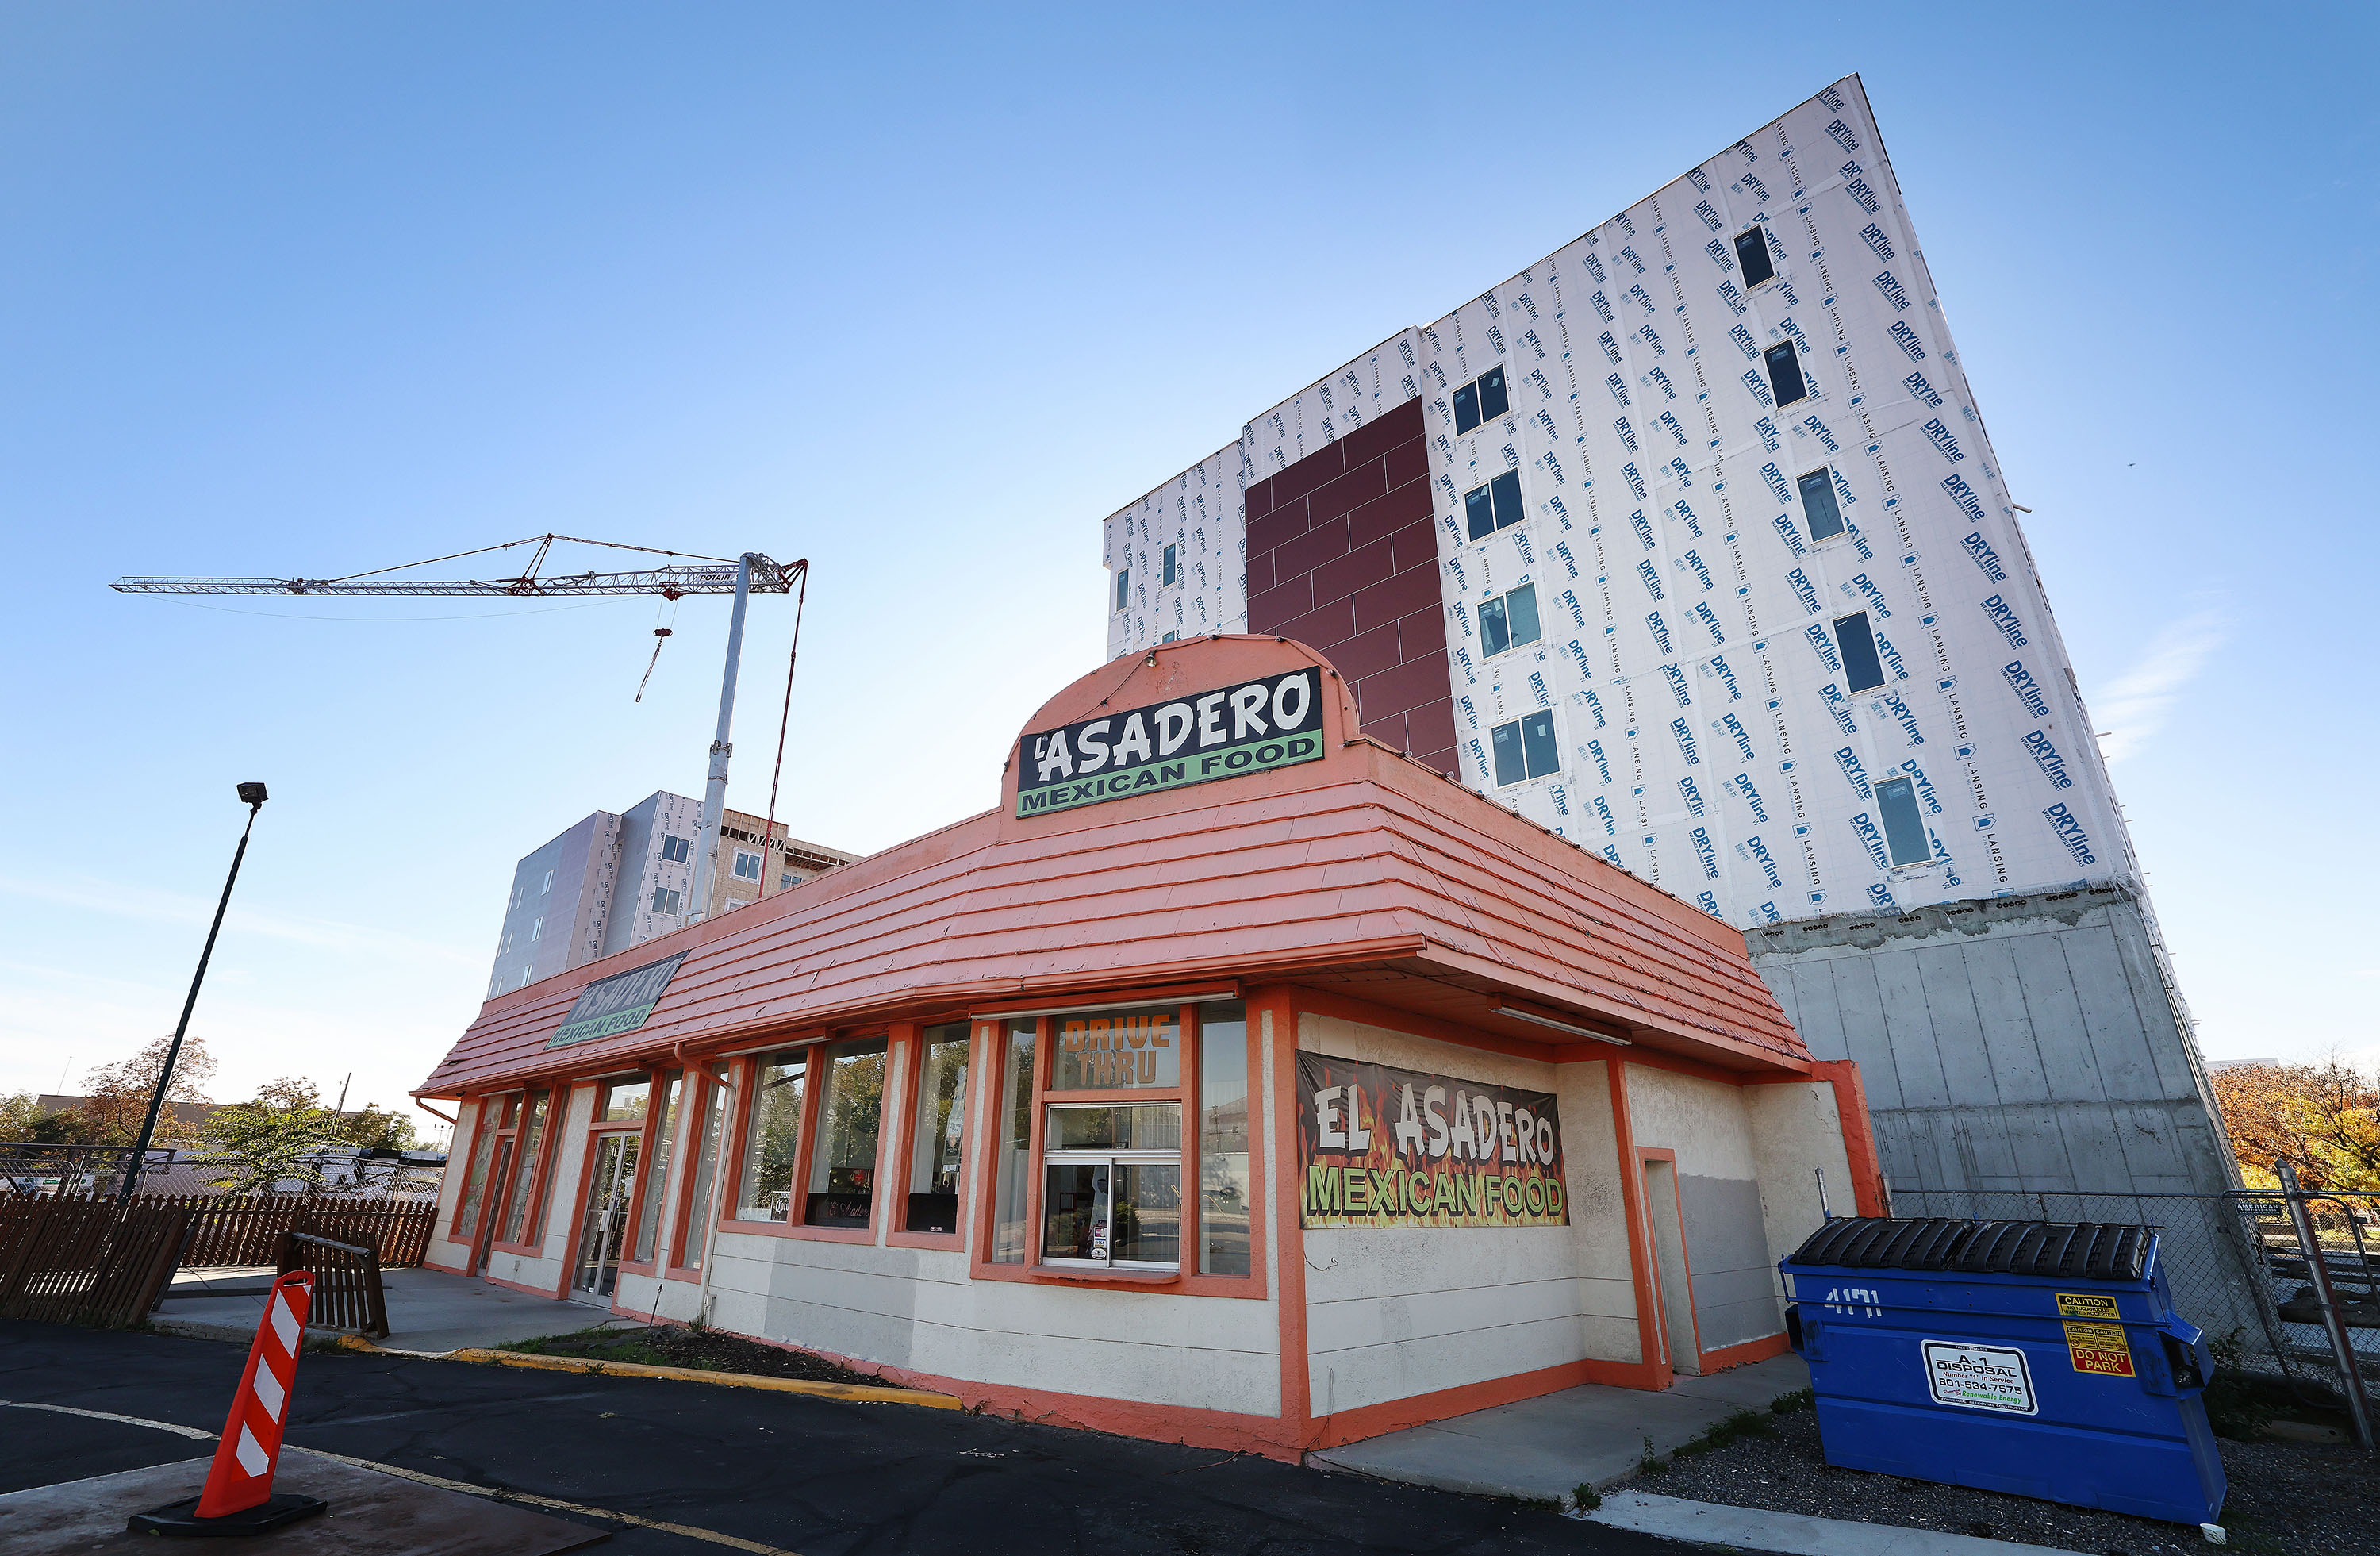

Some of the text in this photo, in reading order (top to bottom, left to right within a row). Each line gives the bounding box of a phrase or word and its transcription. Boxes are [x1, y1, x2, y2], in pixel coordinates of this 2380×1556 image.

[1828, 118, 1860, 151] DRYline
[1695, 199, 1722, 231] DRYline
[1849, 177, 1881, 213] DRYline
[1806, 215, 1819, 246] LANSING
[1862, 223, 1895, 260] DRYline
[1706, 239, 1733, 272] DRYline
[1819, 260, 1832, 292] LANSING
[1875, 271, 1910, 309] DRYline
[1640, 324, 1665, 356] DRYline
[1732, 324, 1760, 359] DRYline
[1780, 317, 1810, 355] DRYline
[1830, 306, 1845, 341] LANSING
[1890, 319, 1926, 361] DRYline
[1346, 371, 1361, 397] DRYline
[1650, 366, 1676, 401] DRYline
[1744, 368, 1772, 407] DRYline
[1844, 355, 1860, 391] LANSING
[1273, 412, 1285, 439] DRYline
[1660, 410, 1687, 447] DRYline
[1705, 401, 1717, 433] LANSING
[1803, 415, 1839, 454] DRYline
[1924, 417, 1965, 462] DRYline
[1544, 451, 1564, 486] DRYline
[1582, 445, 1591, 476] LANSING
[1876, 455, 1892, 492] LANSING
[1764, 461, 1793, 503] DRYline
[1943, 473, 1986, 519] DRYline
[1444, 514, 1463, 547] DRYline
[1632, 509, 1656, 548] DRYline
[1674, 498, 1702, 538] DRYline
[1721, 493, 1733, 528] LANSING
[1894, 509, 1912, 548] LANSING
[1775, 513, 1806, 555] DRYline
[1196, 561, 1207, 587] DRYline
[1556, 541, 1579, 578] DRYline
[1685, 549, 1714, 590] DRYline
[1732, 544, 1745, 581] LANSING
[1960, 540, 1997, 585] WEATHER BARRIER SYSTEMS
[1964, 532, 2006, 581] DRYline
[1640, 559, 1664, 601] DRYline
[1789, 567, 1821, 613] DRYline
[1852, 572, 1891, 620] DRYline
[1913, 567, 1931, 608] LANSING
[1649, 611, 1673, 654] DRYline
[1695, 601, 1725, 644] DRYline
[1745, 598, 1758, 636] LANSING
[1980, 601, 2018, 651] WEATHER BARRIER SYSTEMS
[1984, 594, 2028, 647] DRYline
[1568, 639, 1592, 680] DRYline
[1807, 623, 1841, 671] DRYline
[1932, 629, 1949, 672] LANSING
[1710, 655, 1741, 700] DRYline
[1762, 654, 1777, 693] LANSING
[1999, 667, 2039, 719] WEATHER BARRIER SYSTEMS
[2004, 660, 2049, 716] DRYline
[1626, 686, 1635, 723] LANSING
[1885, 696, 1925, 747] DRYline
[1949, 693, 1967, 739] LANSING
[1674, 717, 1699, 765] DRYline
[1722, 712, 1755, 759] DRYline
[1775, 713, 1791, 755] LANSING
[1022, 738, 1315, 811] MEXICAN FOOD
[1469, 737, 1490, 778] DRYline
[1588, 739, 1612, 785] DRYline
[1633, 742, 1643, 780] LANSING
[1833, 752, 1865, 802] WEATHER BARRIER SYSTEMS
[1837, 746, 1872, 800] DRYline
[2021, 737, 2062, 792] WEATHER BARRIER SYSTEMS
[2025, 729, 2072, 789] DRYline
[1735, 773, 1768, 822] DRYline
[1789, 774, 1804, 817] LANSING
[1900, 759, 1942, 814] DRYline
[1967, 762, 1987, 809] LANSING
[1693, 826, 1719, 879] DRYline
[1848, 818, 1883, 871] WEATHER BARRIER SYSTEMS
[1854, 813, 1888, 868] DRYline
[2041, 809, 2084, 868] WEATHER BARRIER SYSTEMS
[2047, 802, 2096, 864] DRYline
[1747, 835, 1783, 889] DRYline
[1804, 840, 1820, 885] LANSING
[1987, 833, 2008, 883] LANSING
[550, 1009, 647, 1044] MEXICAN FOOD
[1065, 1015, 1169, 1051] DRIVE
[1077, 1051, 1156, 1085] THRU
[1315, 1082, 1554, 1166] EL ASADERO
[1308, 1165, 1563, 1215] MEXICAN FOOD
[2065, 1297, 2108, 1307] CAUTION
[1937, 1362, 2017, 1377] DISPOSAL
[1959, 1354, 1988, 1366] A-1
[2075, 1350, 2125, 1362] DO NOT
[2085, 1359, 2122, 1373] PARK
[1939, 1378, 2022, 1395] 801-534-7575
[1962, 1390, 2022, 1404] Renewable Energy
[1990, 1376, 2014, 1385] Service
